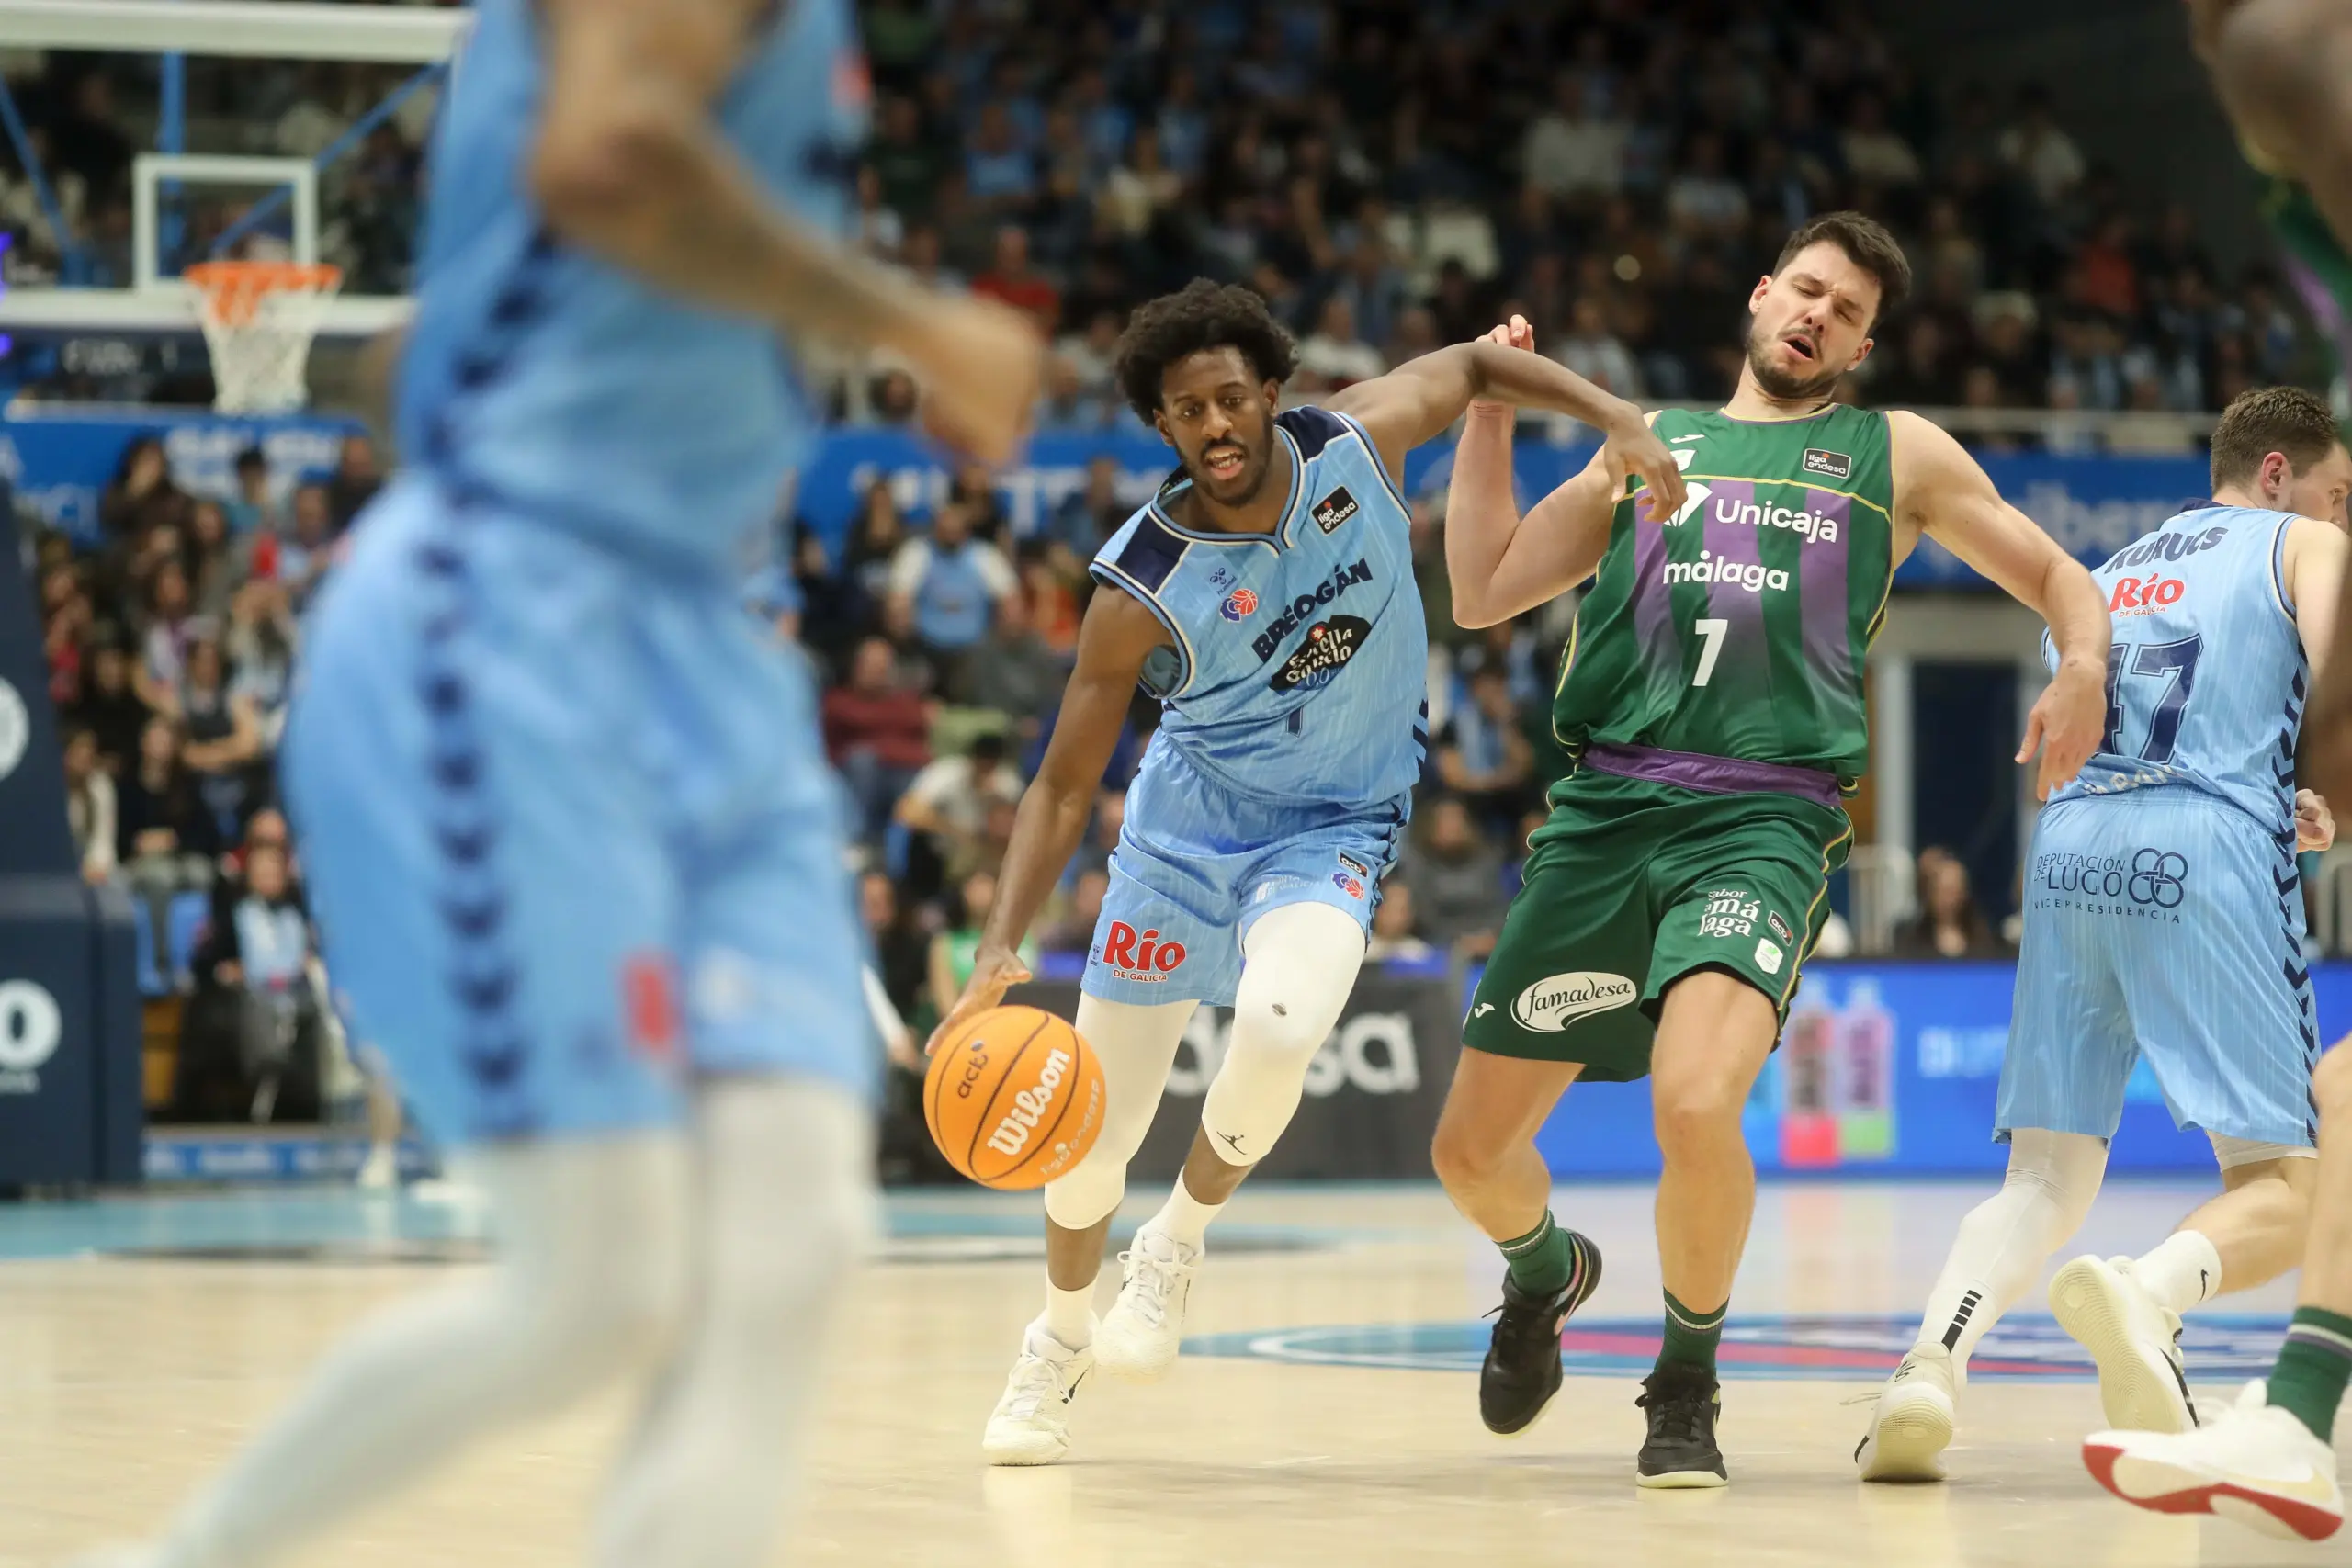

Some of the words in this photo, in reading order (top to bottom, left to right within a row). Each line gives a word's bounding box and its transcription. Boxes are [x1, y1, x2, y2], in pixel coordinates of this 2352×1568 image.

[1808, 454, 1827, 463] liga
[1808, 461, 1846, 474] endesa
[1318, 508, 1334, 524] liga
[1324, 502, 1356, 530] endesa
[1715, 498, 1838, 544] Unicaja
[2104, 526, 2229, 575] KURUCS
[2109, 572, 2185, 613] Río
[1252, 558, 1373, 664] BREOGÁN
[1692, 618, 1729, 687] 7
[1341, 857, 1362, 874] acb
[2037, 852, 2126, 872] DEPUTACIÓN
[1708, 888, 1748, 900] sabor
[2034, 866, 2046, 881] DE
[2048, 866, 2122, 897] LUGO
[2034, 897, 2180, 924] VICEPRESIDENCIA
[1771, 918, 1787, 938] acb
[1102, 920, 1186, 972] Río
[1114, 969, 1126, 978] DE
[1129, 973, 1167, 982] GALICIA
[1524, 976, 1631, 1021] famadesa
[957, 1054, 989, 1099] acb
[987, 1048, 1070, 1156] Wilson
